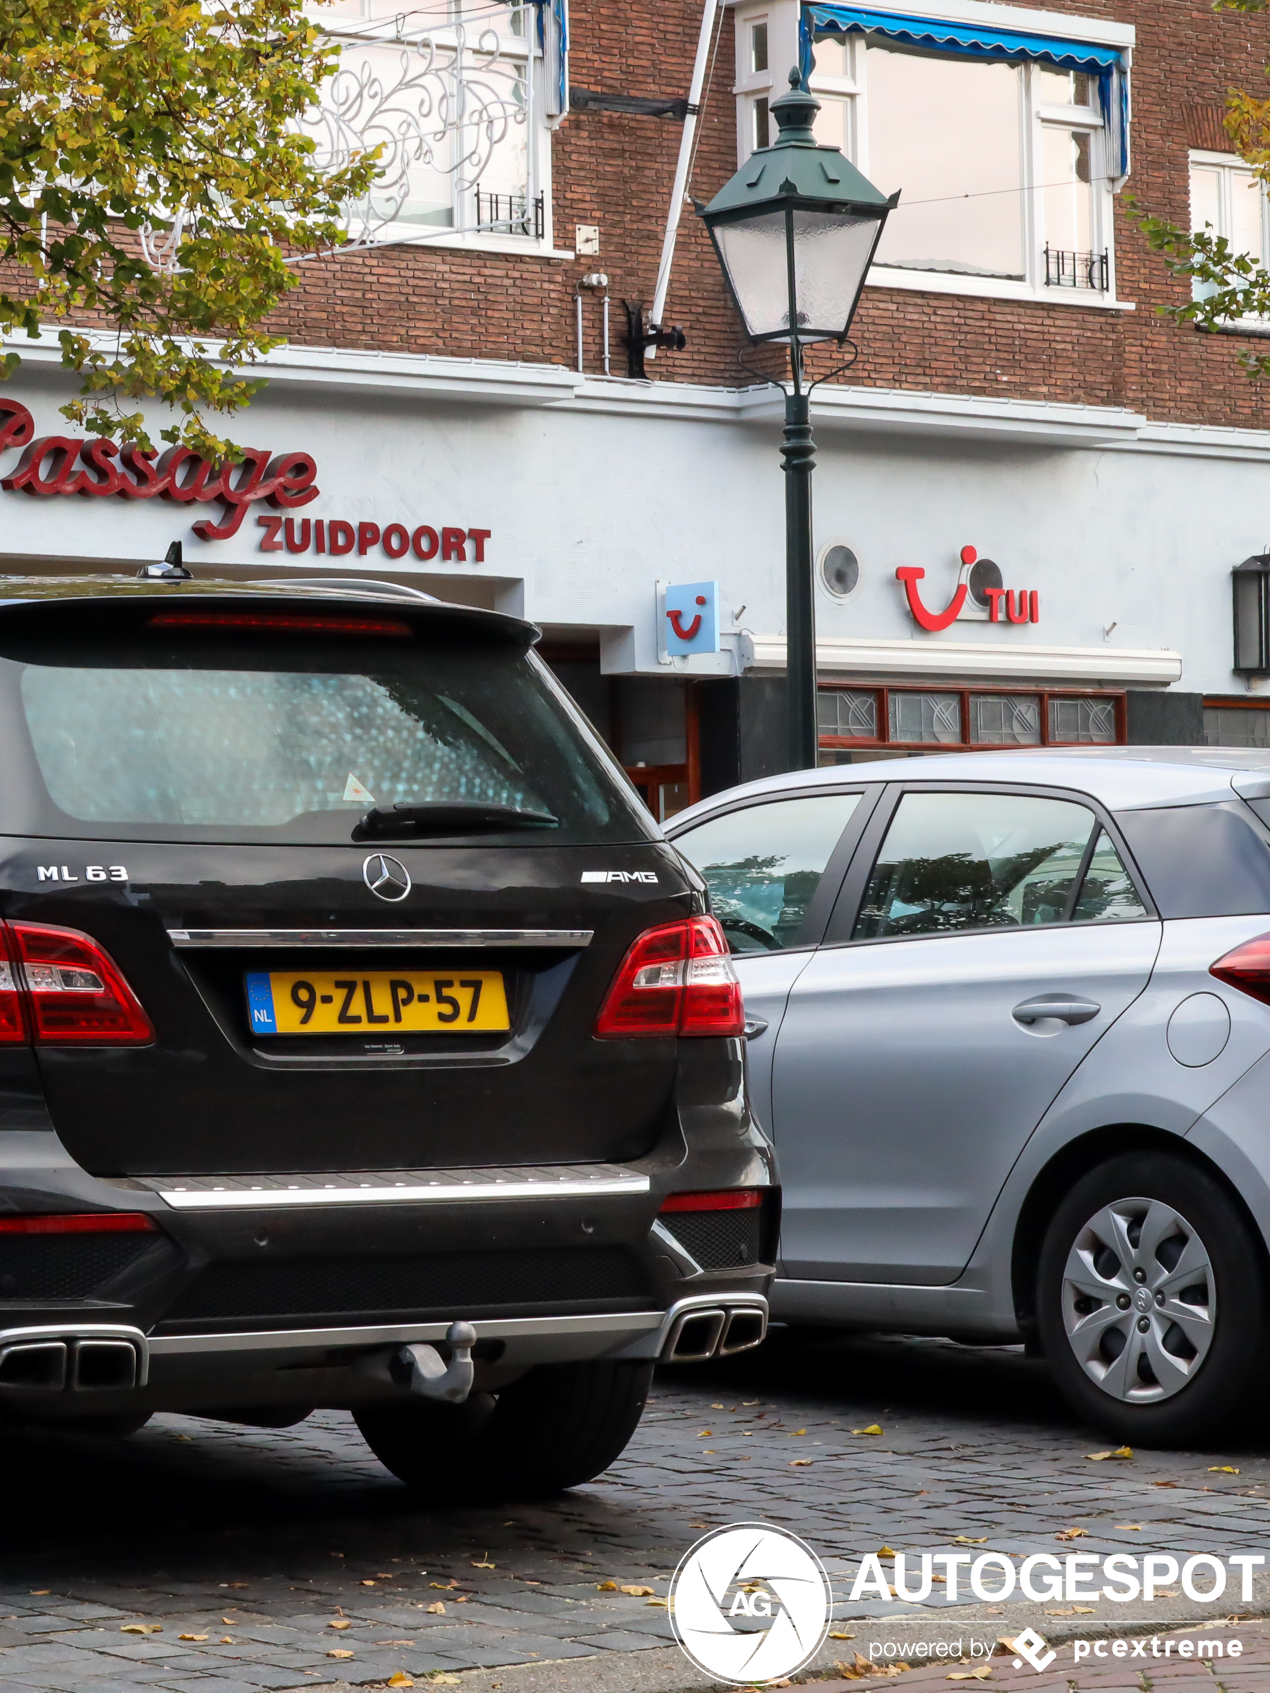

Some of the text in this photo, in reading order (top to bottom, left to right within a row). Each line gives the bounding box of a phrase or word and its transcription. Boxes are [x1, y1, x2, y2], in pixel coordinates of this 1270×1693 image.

[257, 515, 491, 562] ZUIDPOORT
[983, 588, 1039, 624] TUI
[36, 865, 129, 882] ML 63
[606, 871, 659, 883] AMG
[290, 979, 484, 1025] 9-ZLP-57
[253, 1008, 273, 1024] NL
